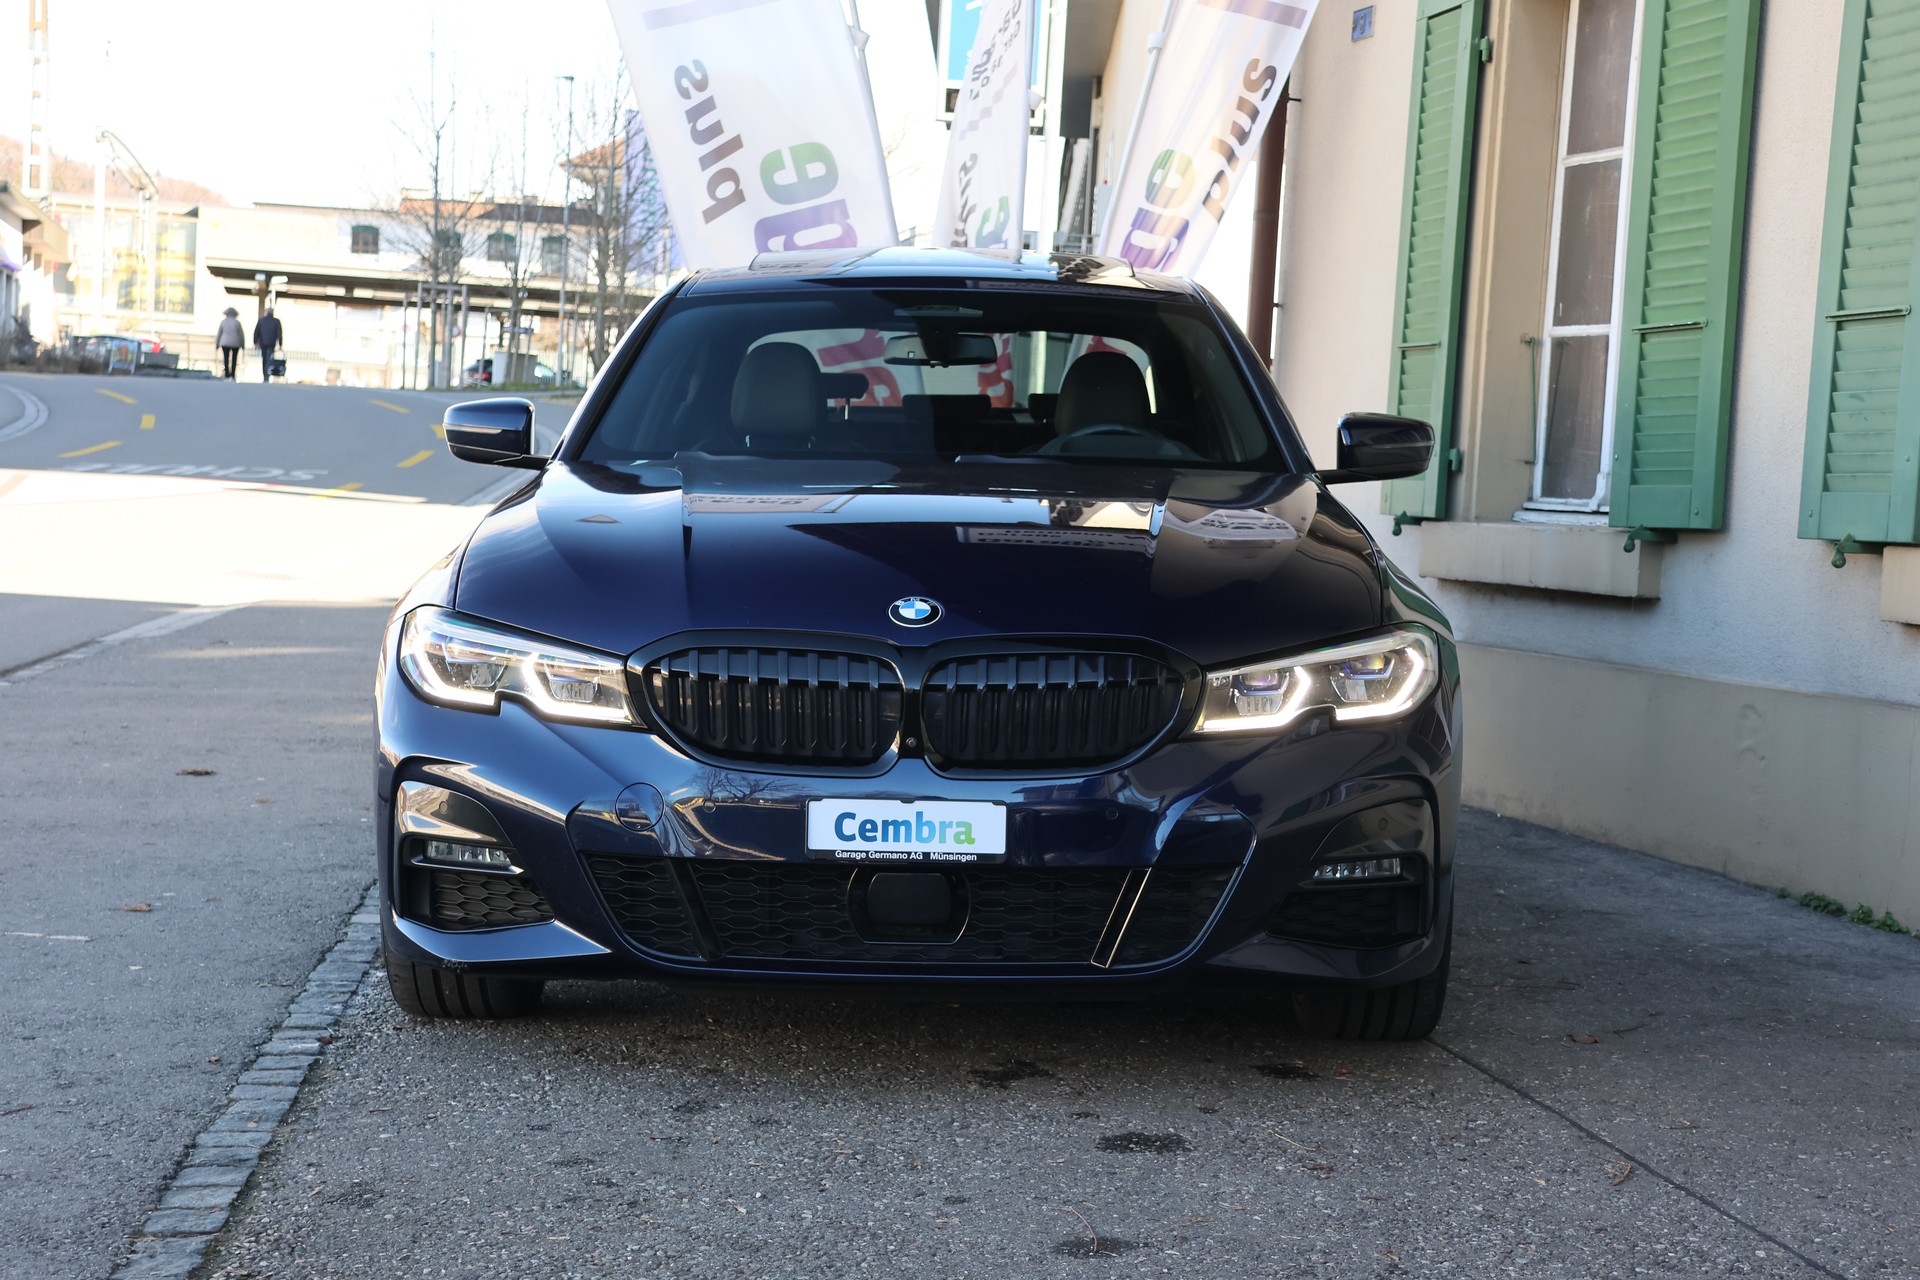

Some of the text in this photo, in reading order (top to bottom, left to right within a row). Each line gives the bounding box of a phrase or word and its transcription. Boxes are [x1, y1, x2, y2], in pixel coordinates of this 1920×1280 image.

[1202, 57, 1278, 224] plus
[835, 811, 975, 845] Cembra
[835, 849, 977, 863] Garage Germano AG Münsingen
